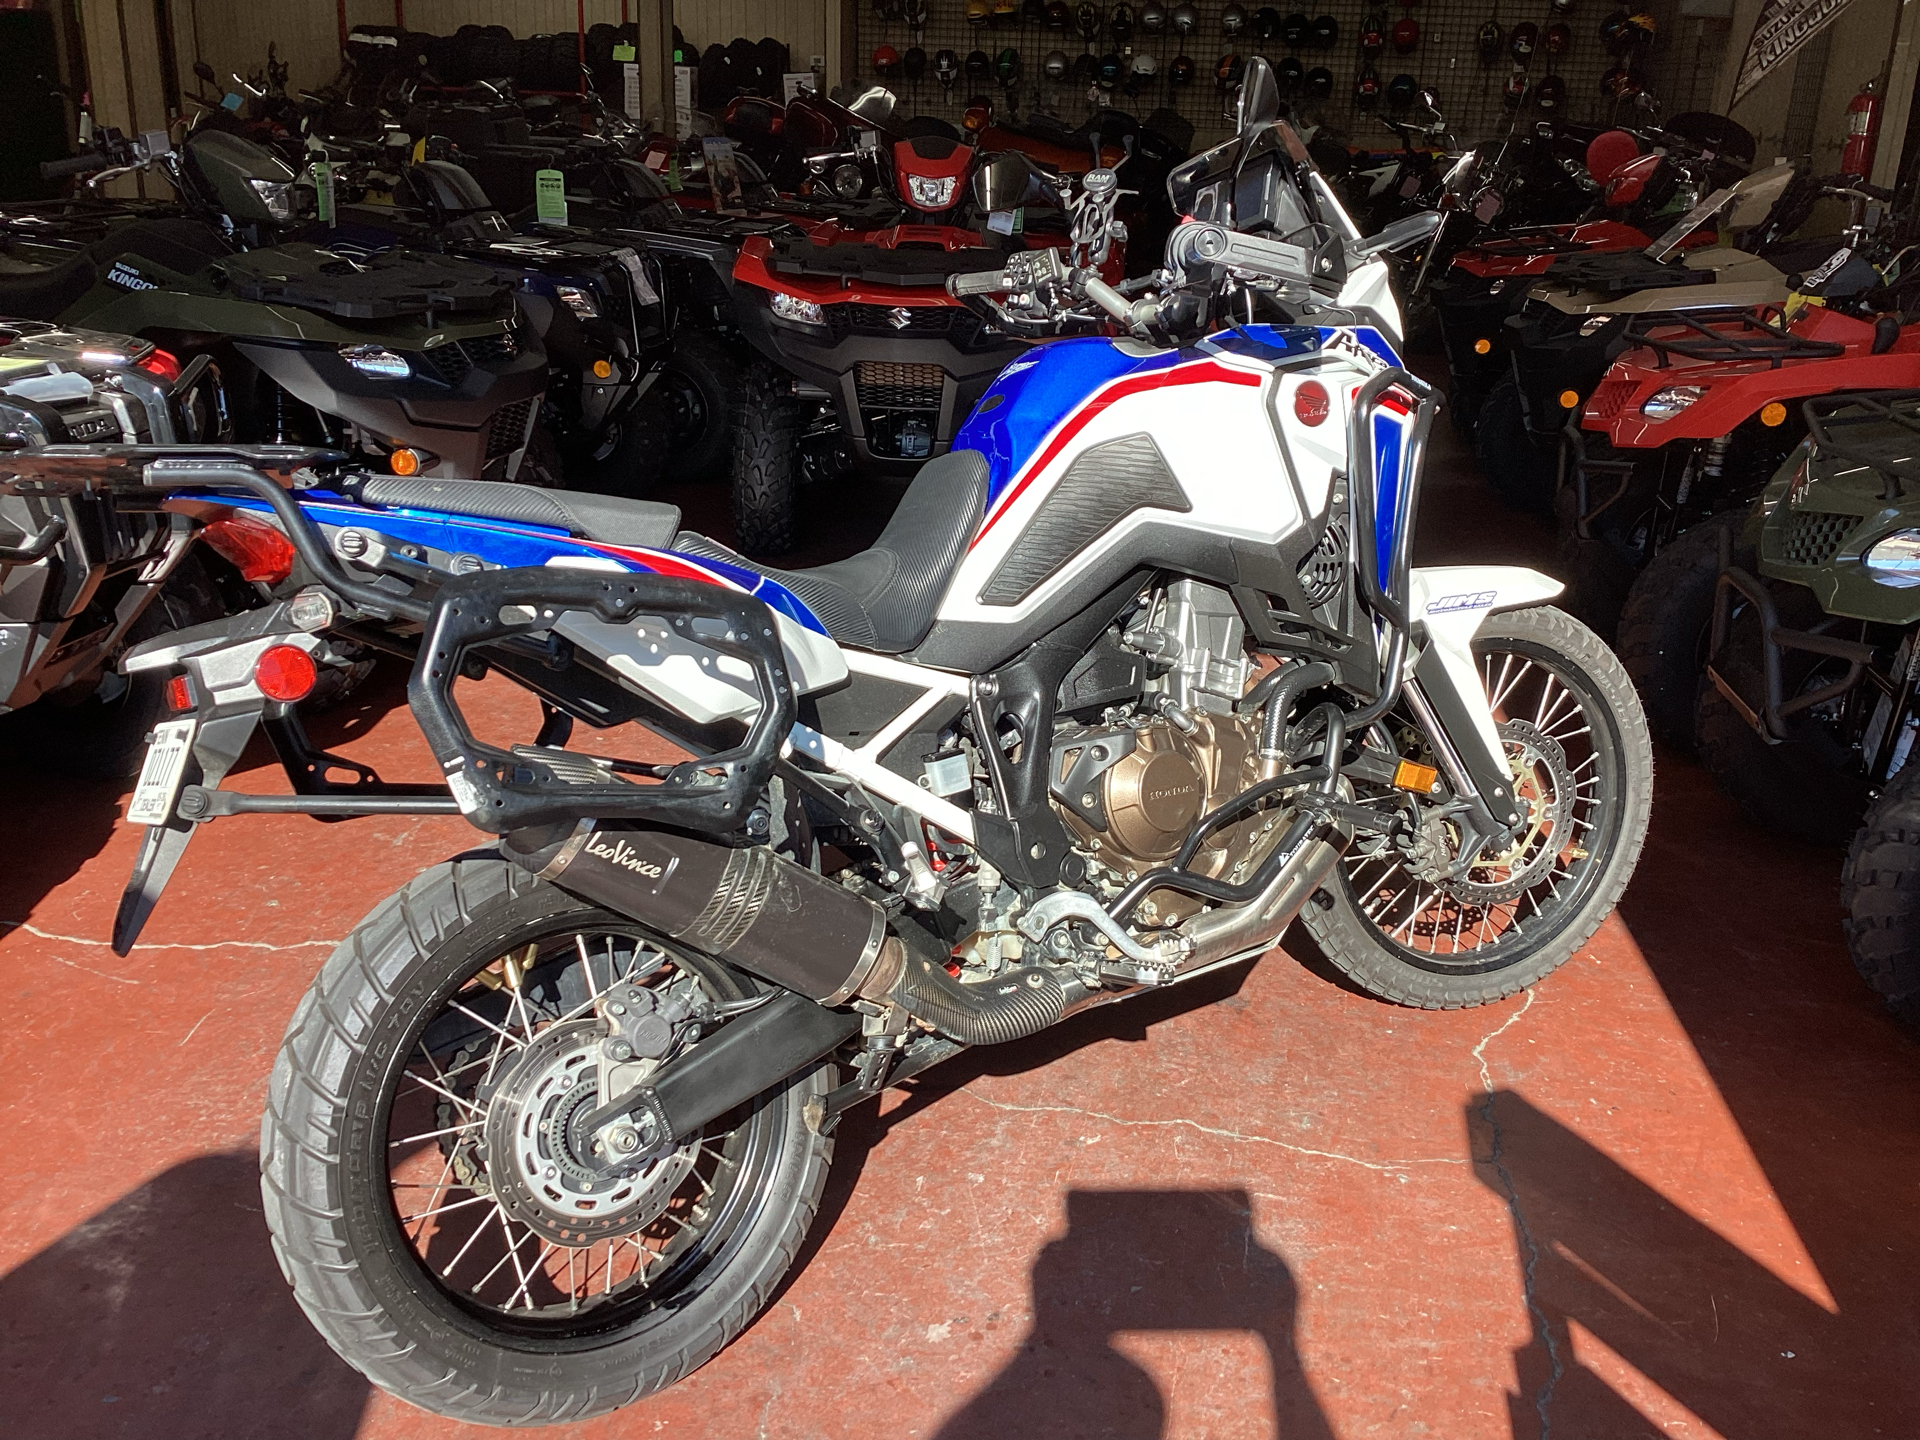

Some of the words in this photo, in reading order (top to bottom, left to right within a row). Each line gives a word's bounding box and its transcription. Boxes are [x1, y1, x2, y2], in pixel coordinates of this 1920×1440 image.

[1753, 2, 1805, 49] SUZUKI
[1758, 0, 1842, 70] KINGQU
[1086, 173, 1111, 183] RAM
[1426, 590, 1497, 611] JIMS
[1150, 784, 1194, 801] HONDA
[584, 830, 662, 879] LeoVince
